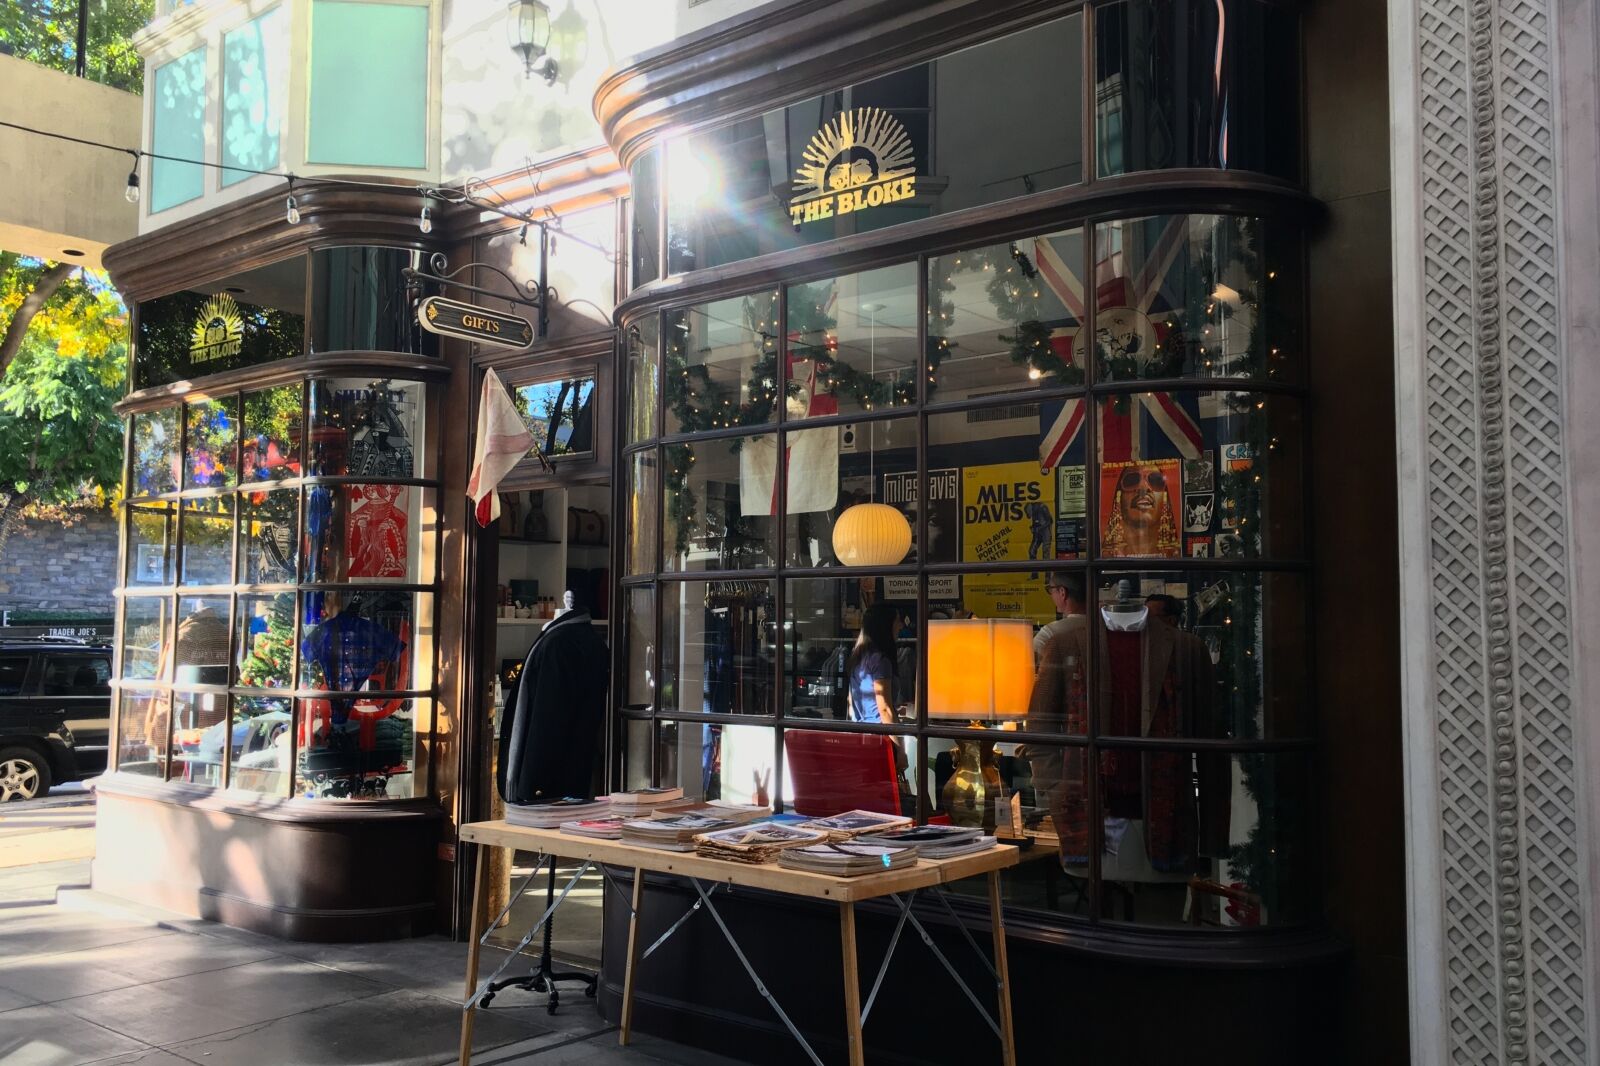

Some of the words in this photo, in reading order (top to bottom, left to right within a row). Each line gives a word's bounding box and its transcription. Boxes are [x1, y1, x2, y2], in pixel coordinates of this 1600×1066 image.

[790, 196, 833, 226] THE
[837, 176, 916, 215] BLOKE
[462, 314, 499, 333] GIFTS
[190, 347, 209, 365] THE
[210, 339, 242, 361] BLOKE
[886, 475, 919, 504] miles
[929, 472, 955, 500] avis
[977, 481, 1041, 504] MILES
[966, 501, 1024, 524] DAVIS
[992, 525, 1013, 542] AVRIL
[977, 541, 1002, 561] PORTE
[888, 579, 913, 587] TORINO
[996, 602, 1021, 610] Busch
[48, 628, 75, 636] TRADER
[78, 627, 96, 636] JOE'S
